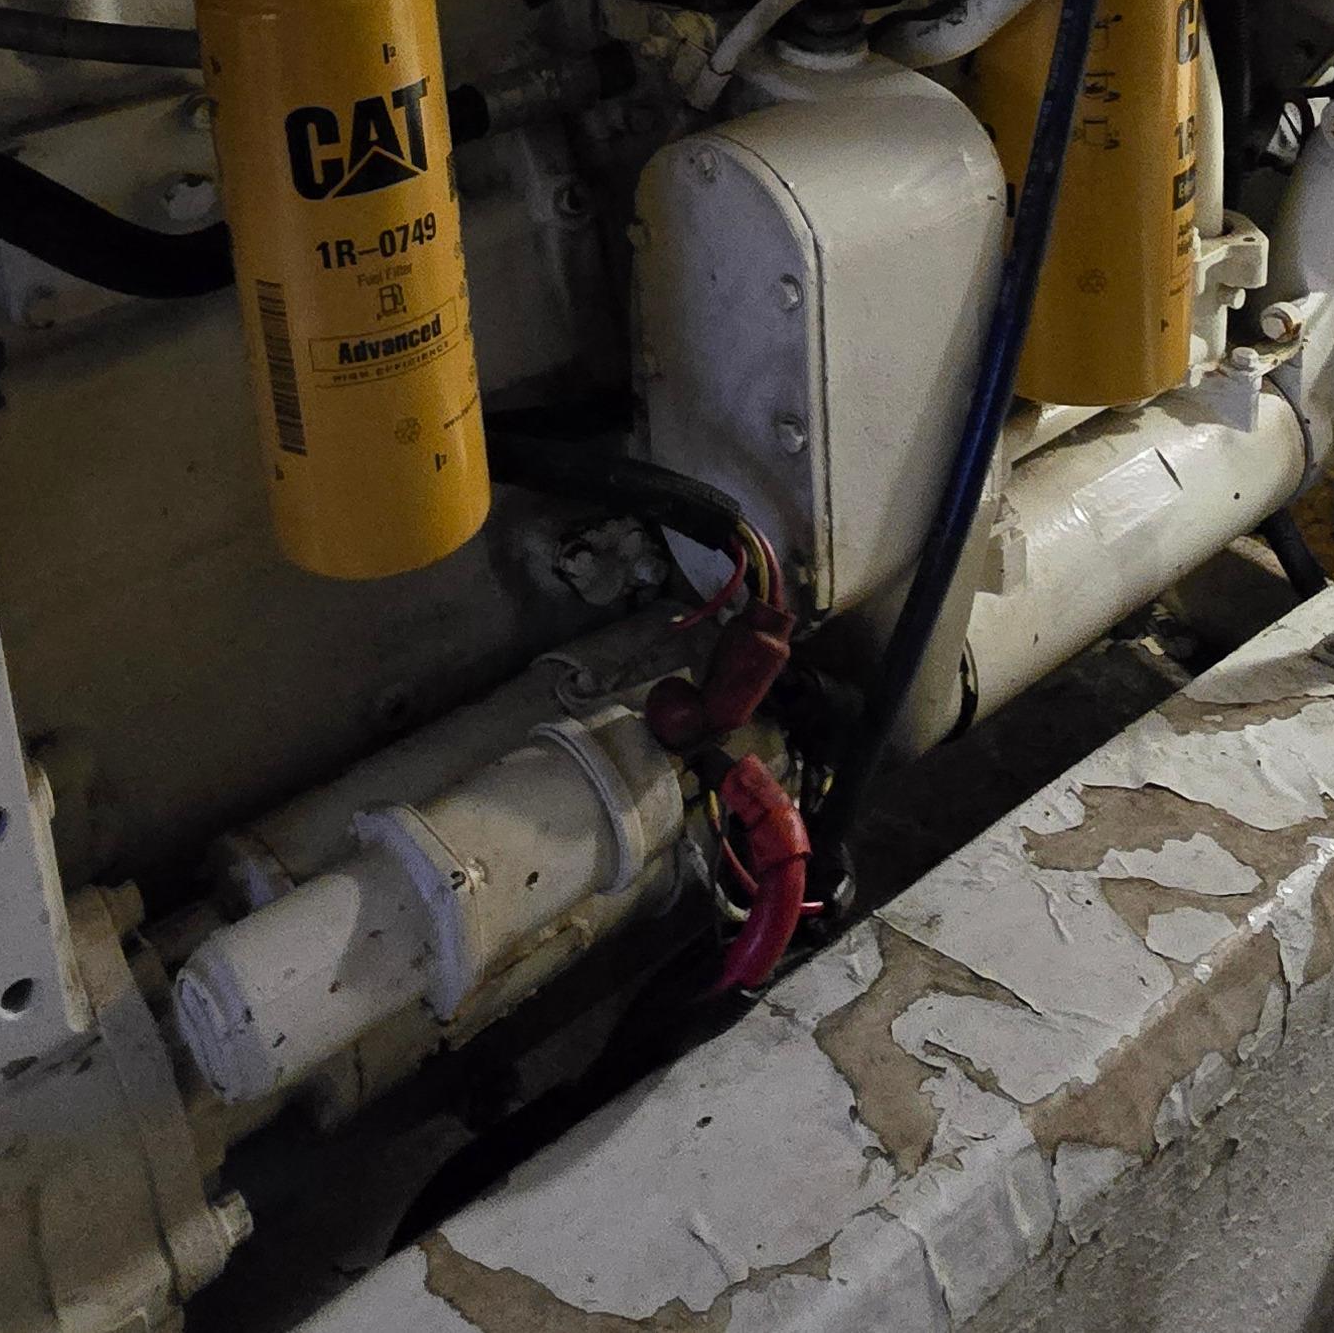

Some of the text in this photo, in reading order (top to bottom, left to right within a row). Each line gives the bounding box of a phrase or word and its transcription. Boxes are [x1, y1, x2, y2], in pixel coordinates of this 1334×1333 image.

[285, 78, 427, 200] CAT
[314, 212, 437, 269] 1R-0749
[356, 269, 381, 287] Fuel
[338, 313, 442, 365] Advanced
